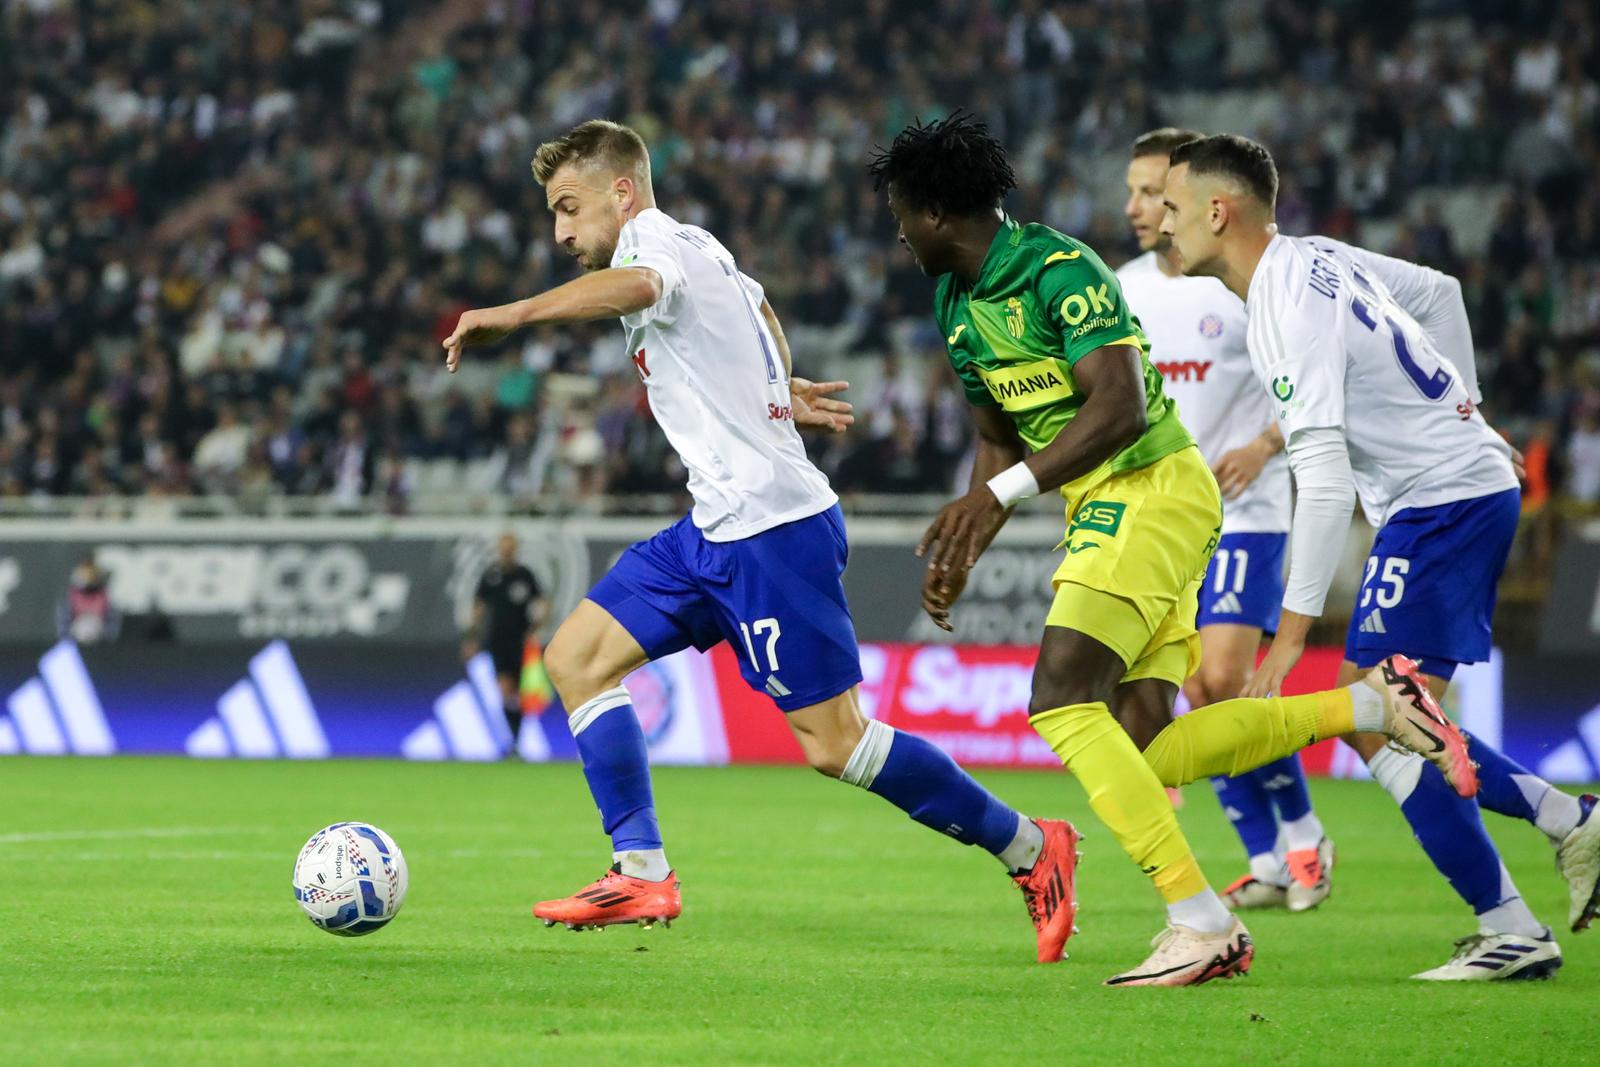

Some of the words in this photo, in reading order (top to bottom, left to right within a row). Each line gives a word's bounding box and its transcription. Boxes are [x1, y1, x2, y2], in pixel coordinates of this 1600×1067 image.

[1060, 283, 1115, 326] OK
[1213, 548, 1249, 594] 11
[1360, 555, 1410, 609] 25
[739, 617, 781, 673] 17
[334, 844, 345, 880] uhlsport
